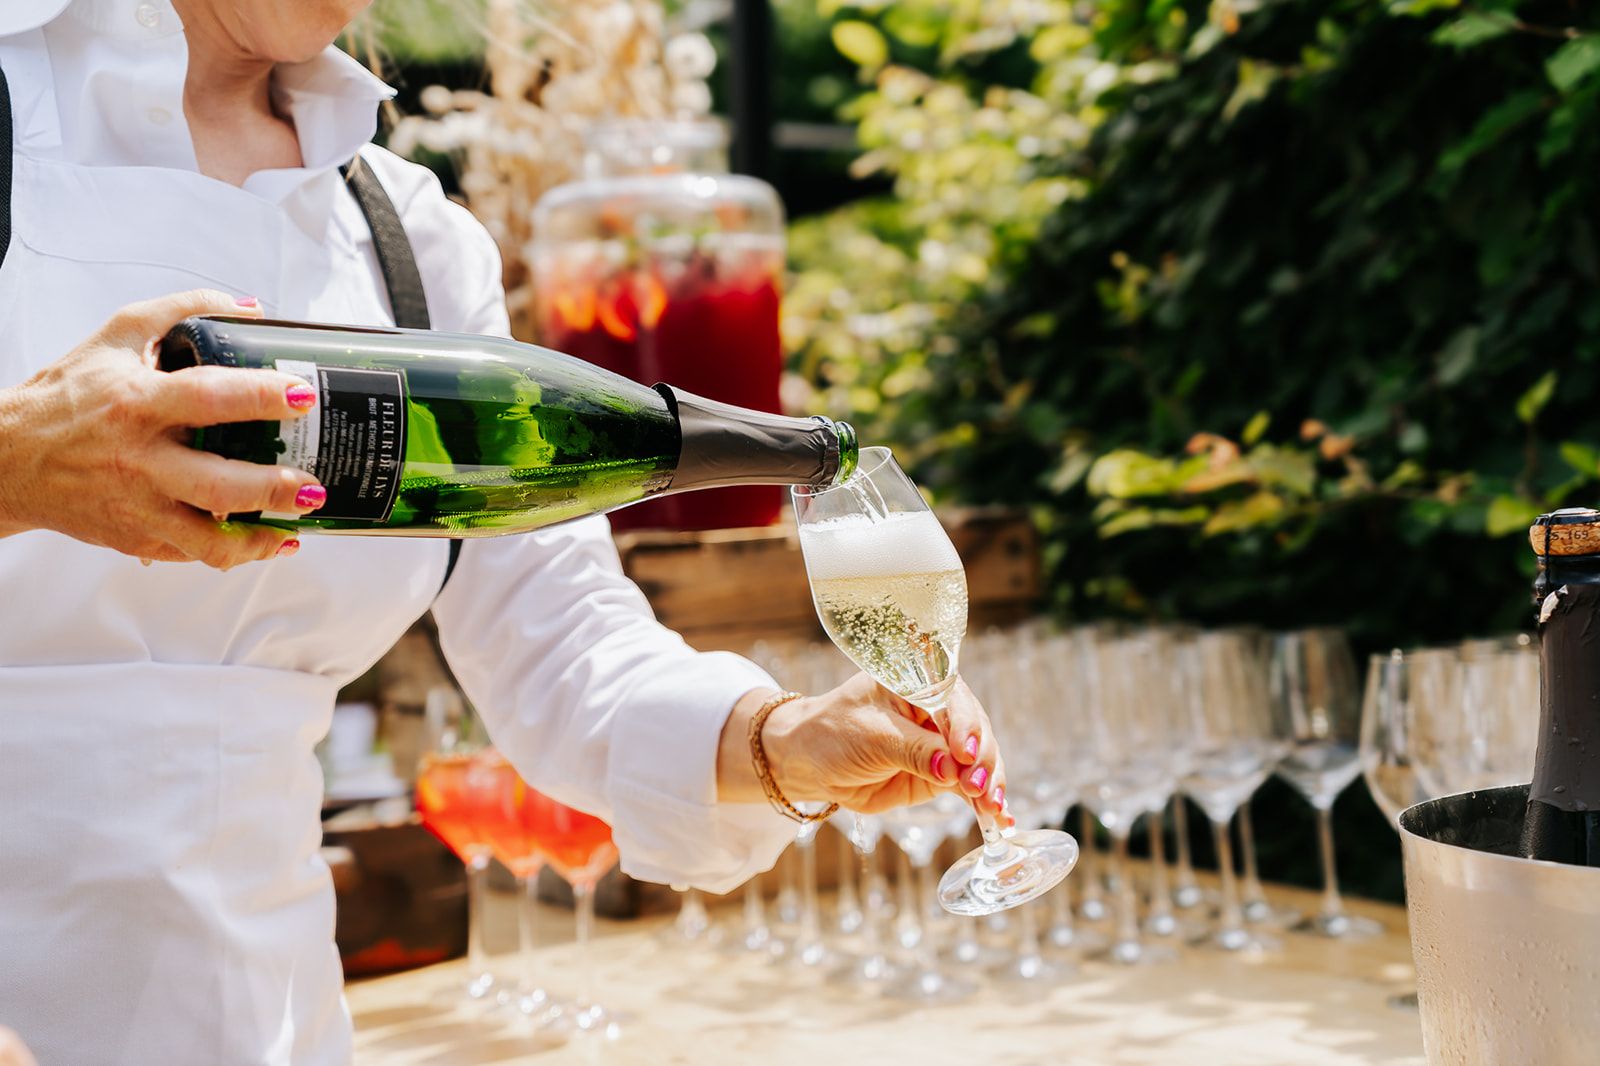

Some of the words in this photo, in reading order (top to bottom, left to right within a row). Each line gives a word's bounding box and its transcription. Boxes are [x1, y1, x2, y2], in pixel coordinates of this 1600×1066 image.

[368, 397, 377, 415] BRUT
[367, 420, 377, 450] MÉTHODE
[382, 402, 394, 449] FLEUR
[357, 452, 374, 498] TRADITIONNELLE
[378, 453, 391, 472] DE
[374, 476, 388, 498] LYS
